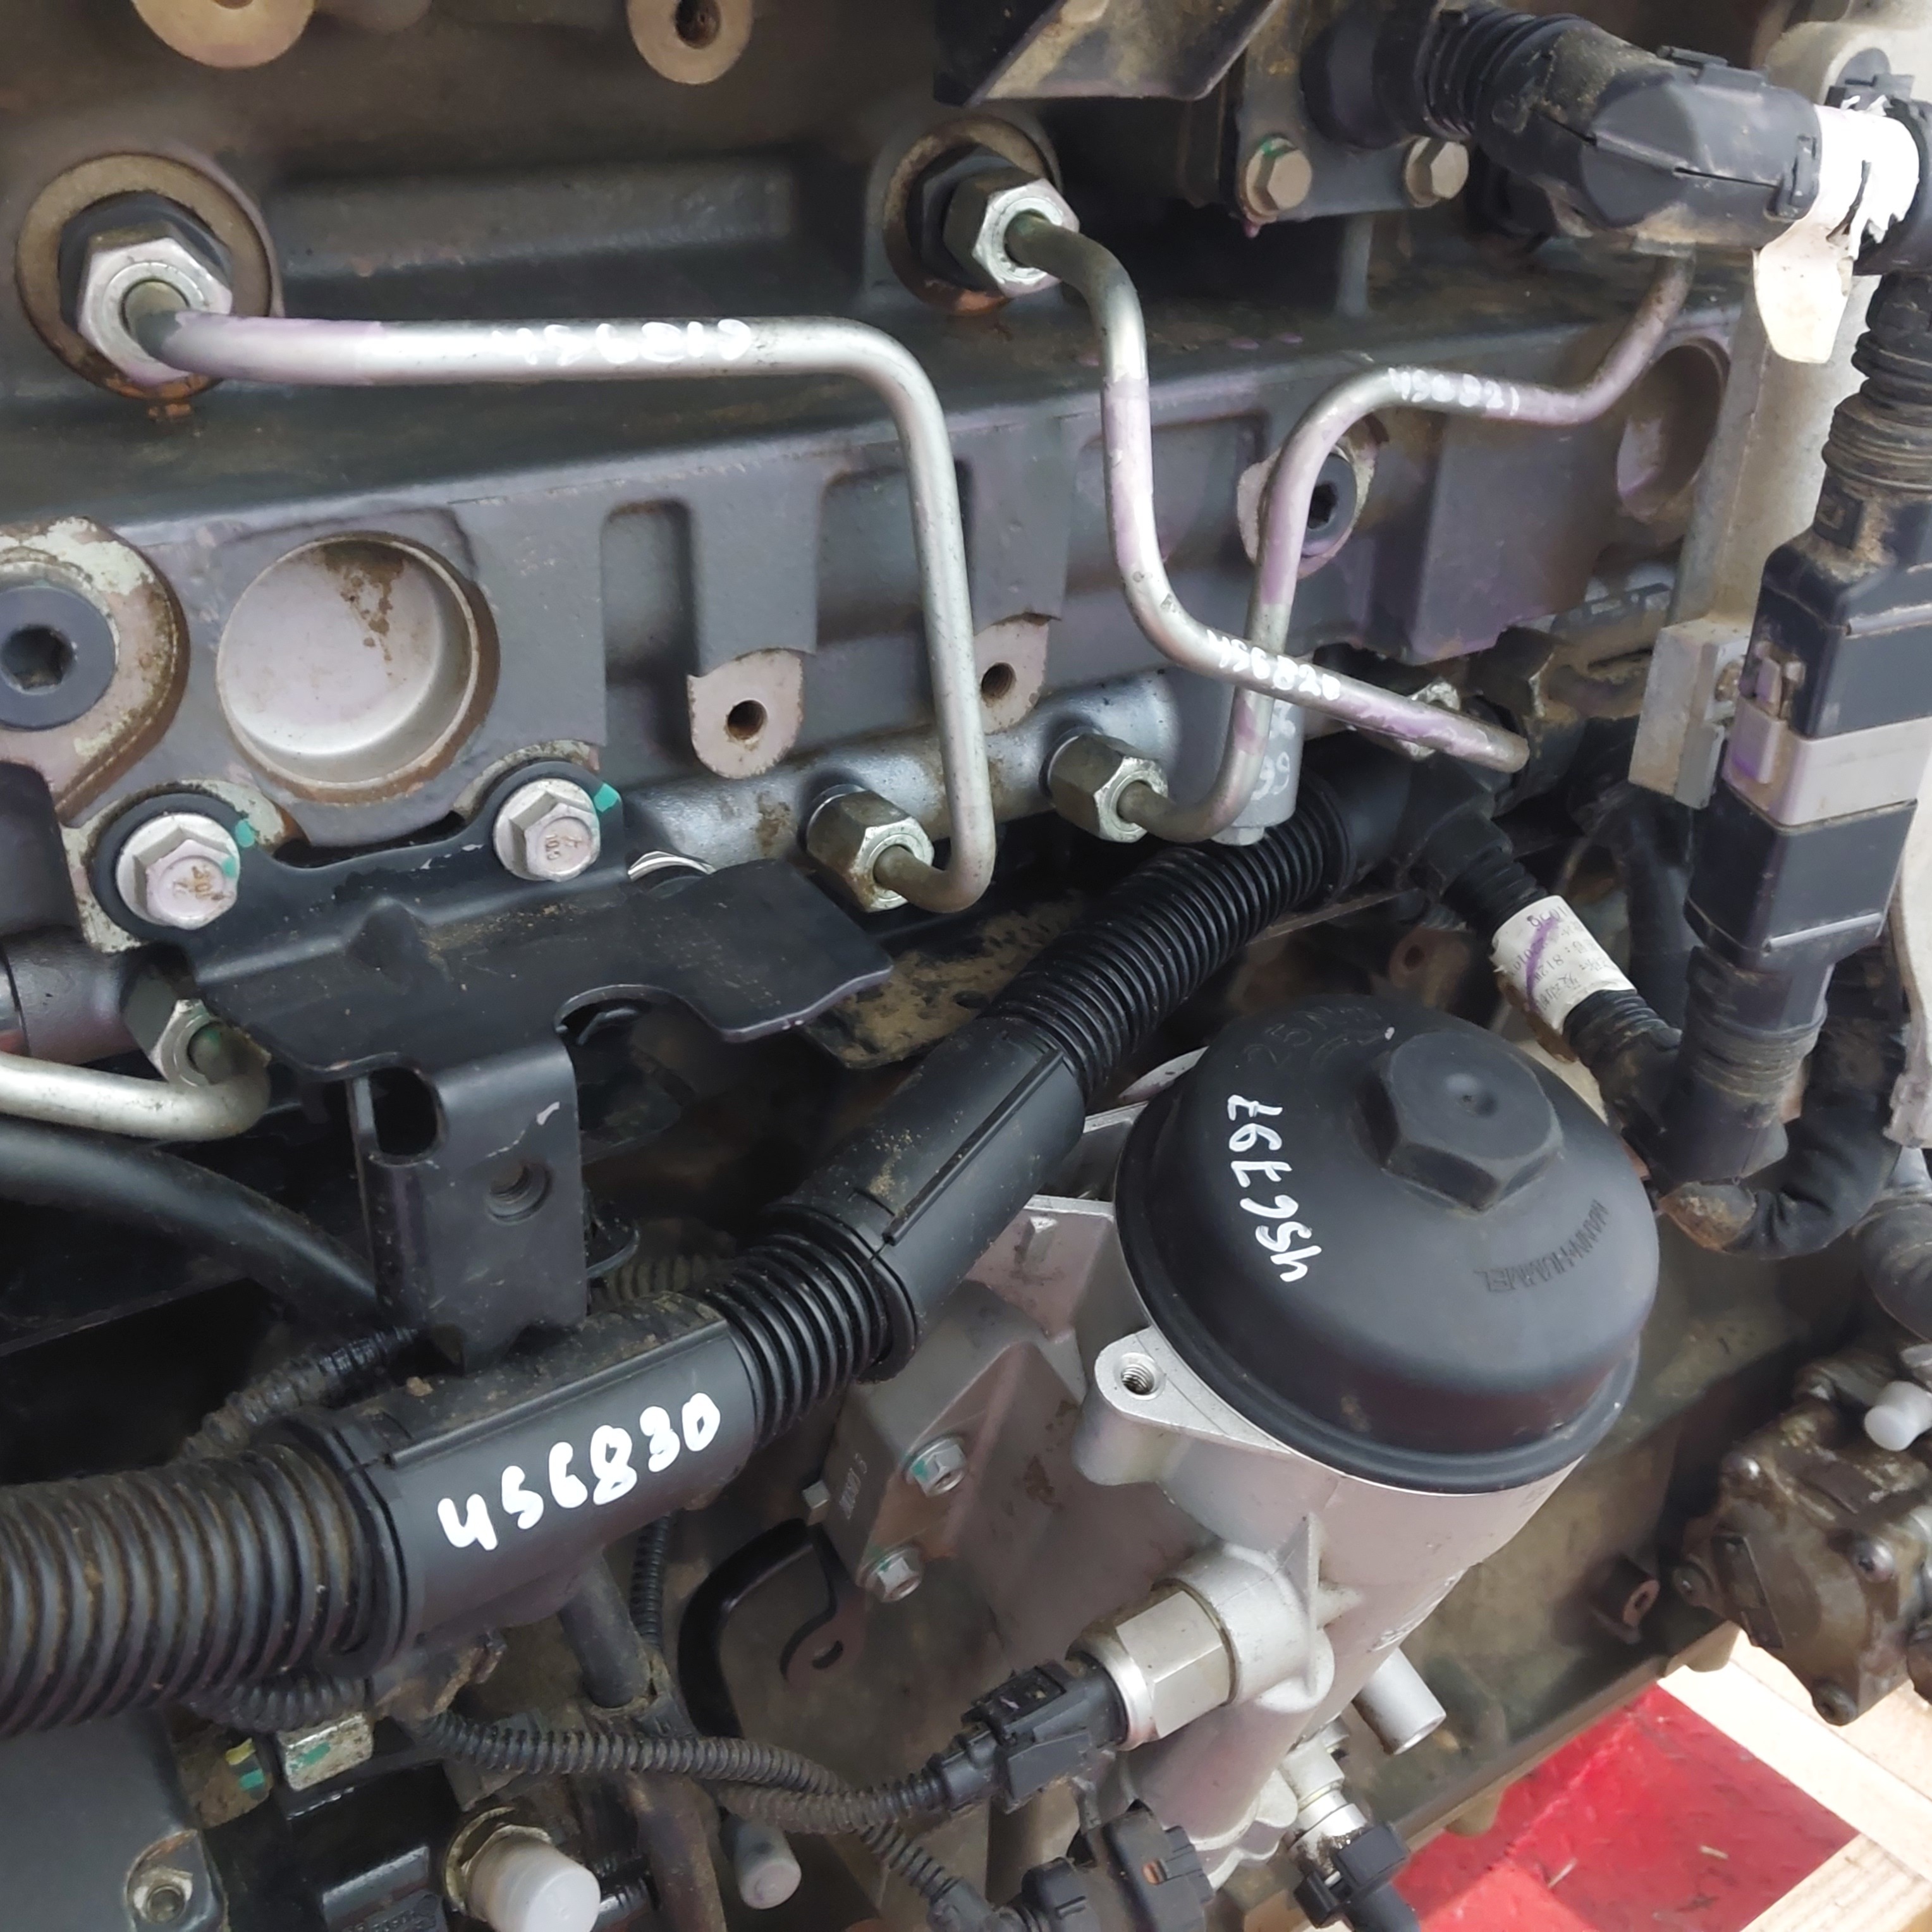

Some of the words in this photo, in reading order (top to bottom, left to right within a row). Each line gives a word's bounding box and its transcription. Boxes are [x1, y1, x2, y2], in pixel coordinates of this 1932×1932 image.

[1206, 629, 1341, 701] 456820
[1227, 1094, 1322, 1282] 456797
[437, 1393, 720, 1550] 456830
